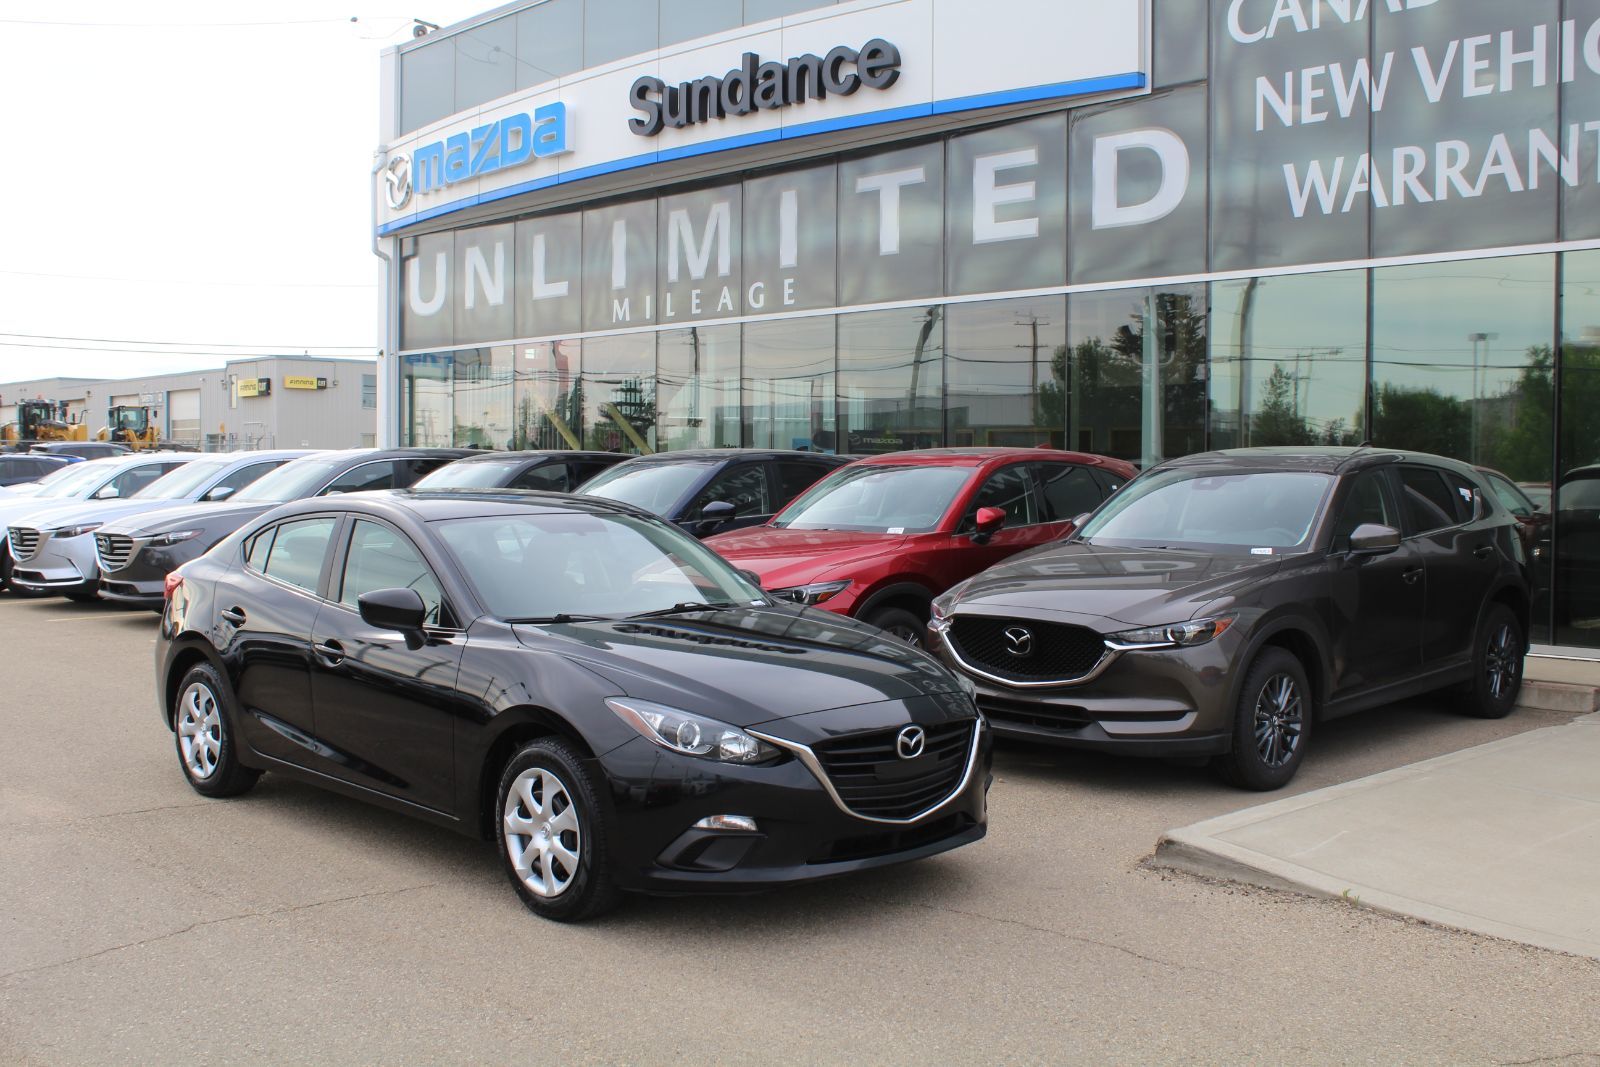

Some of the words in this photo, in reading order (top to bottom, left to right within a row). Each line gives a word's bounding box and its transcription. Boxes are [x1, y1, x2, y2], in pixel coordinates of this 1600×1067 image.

[628, 38, 901, 137] Sundance
[1256, 51, 1394, 131] NEW
[413, 101, 569, 195] mazda
[409, 129, 1190, 317] UNLIMITED
[612, 278, 796, 323] MILEAGE
